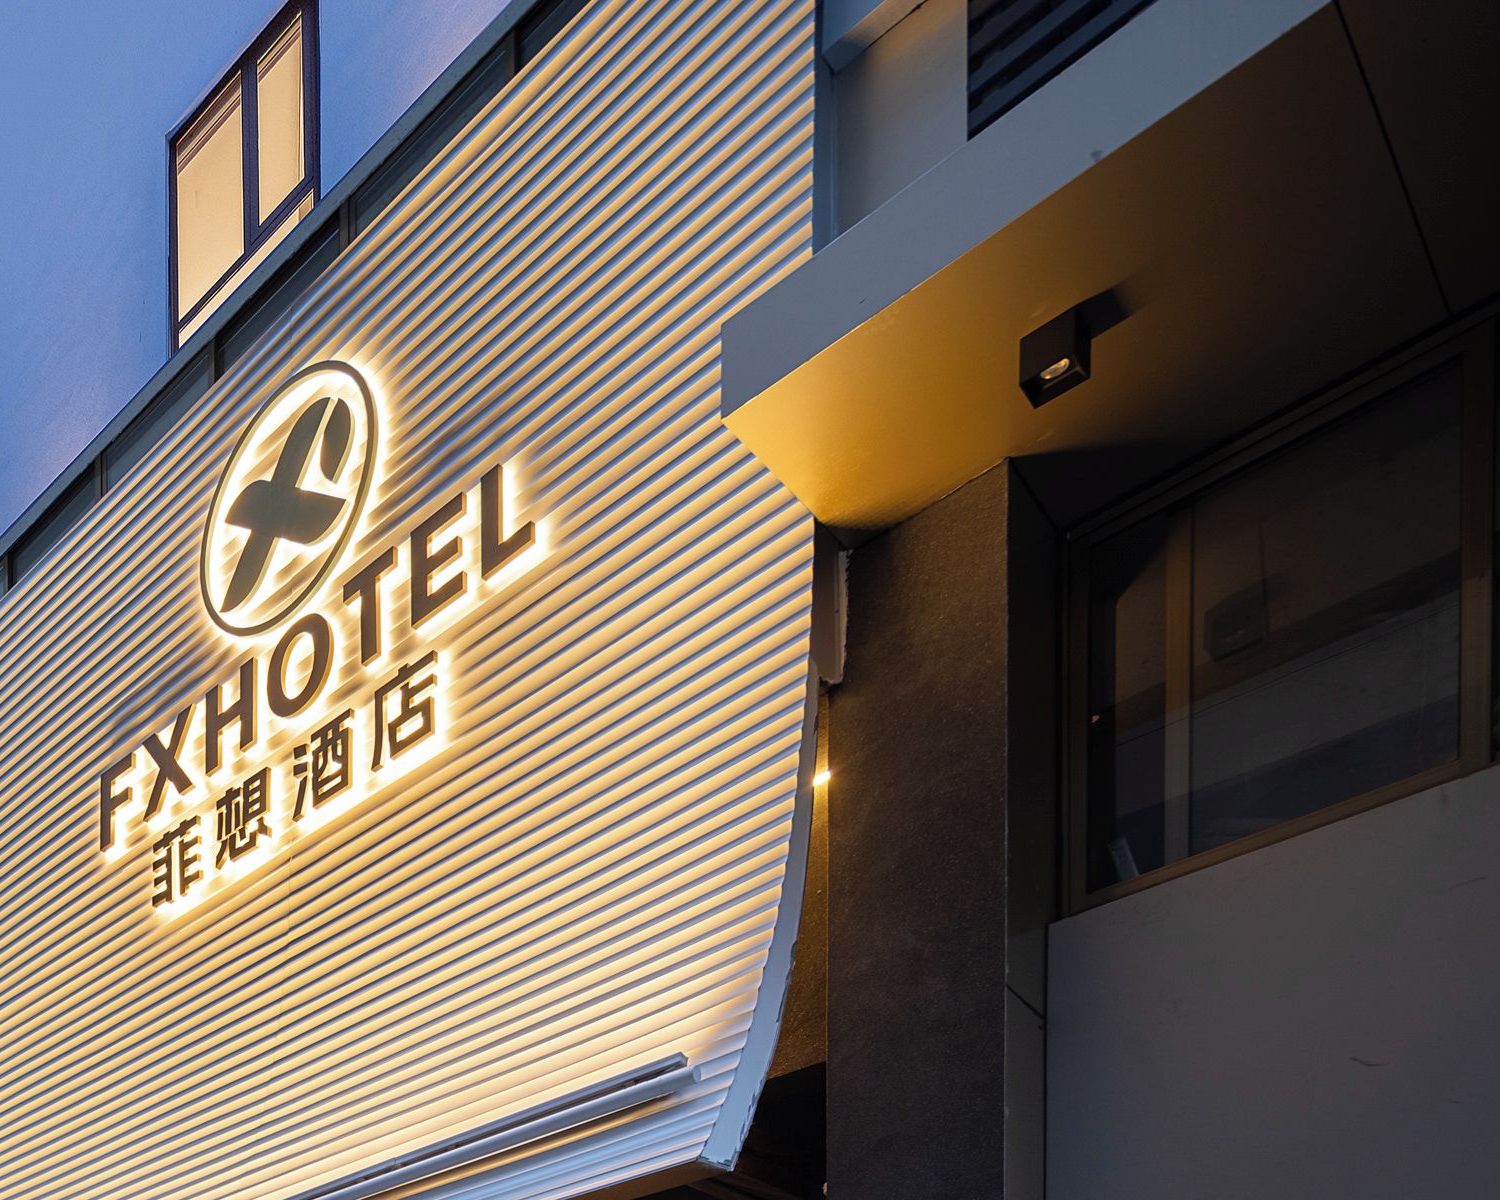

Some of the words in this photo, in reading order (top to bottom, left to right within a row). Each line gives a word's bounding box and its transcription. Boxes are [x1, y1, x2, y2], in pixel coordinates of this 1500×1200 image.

[100, 463, 536, 852] FXHOTEL
[151, 650, 438, 907] 菲想酒店
